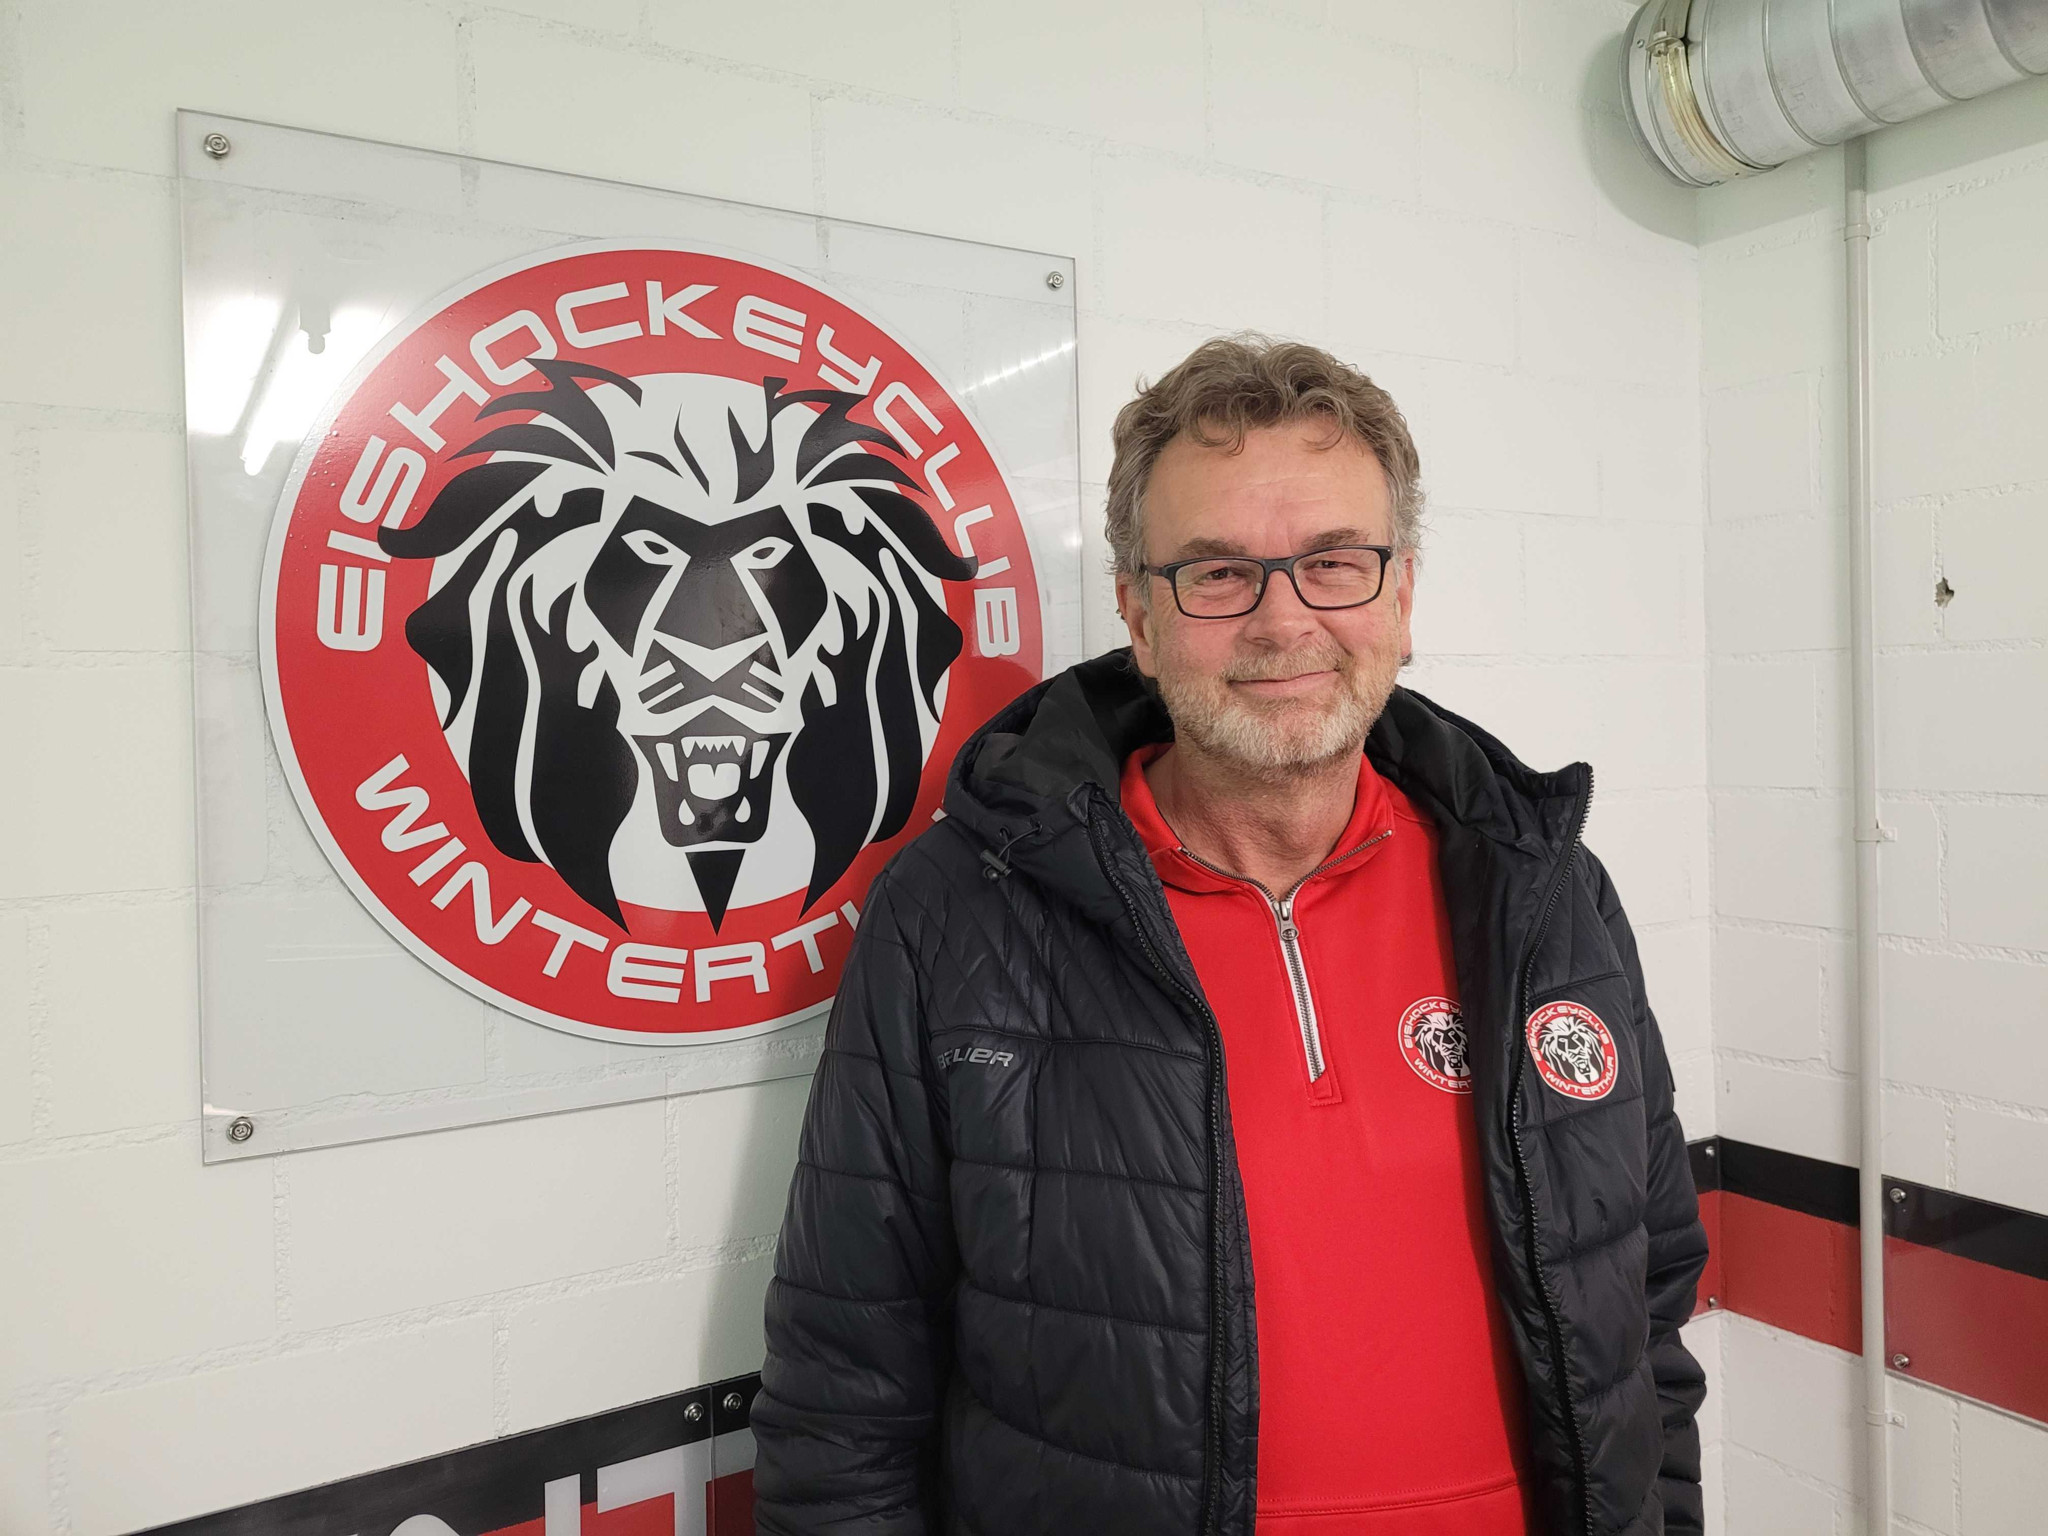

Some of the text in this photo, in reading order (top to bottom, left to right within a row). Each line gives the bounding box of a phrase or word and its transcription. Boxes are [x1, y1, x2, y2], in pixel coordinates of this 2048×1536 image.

[317, 280, 1020, 658] EISHOCKEYCLUB
[355, 754, 947, 1004] WINTERT
[1403, 1001, 1463, 1049] EISHOCKEY
[1414, 1057, 1472, 1089] WINTER
[1545, 1055, 1614, 1096] WINTERTHUR
